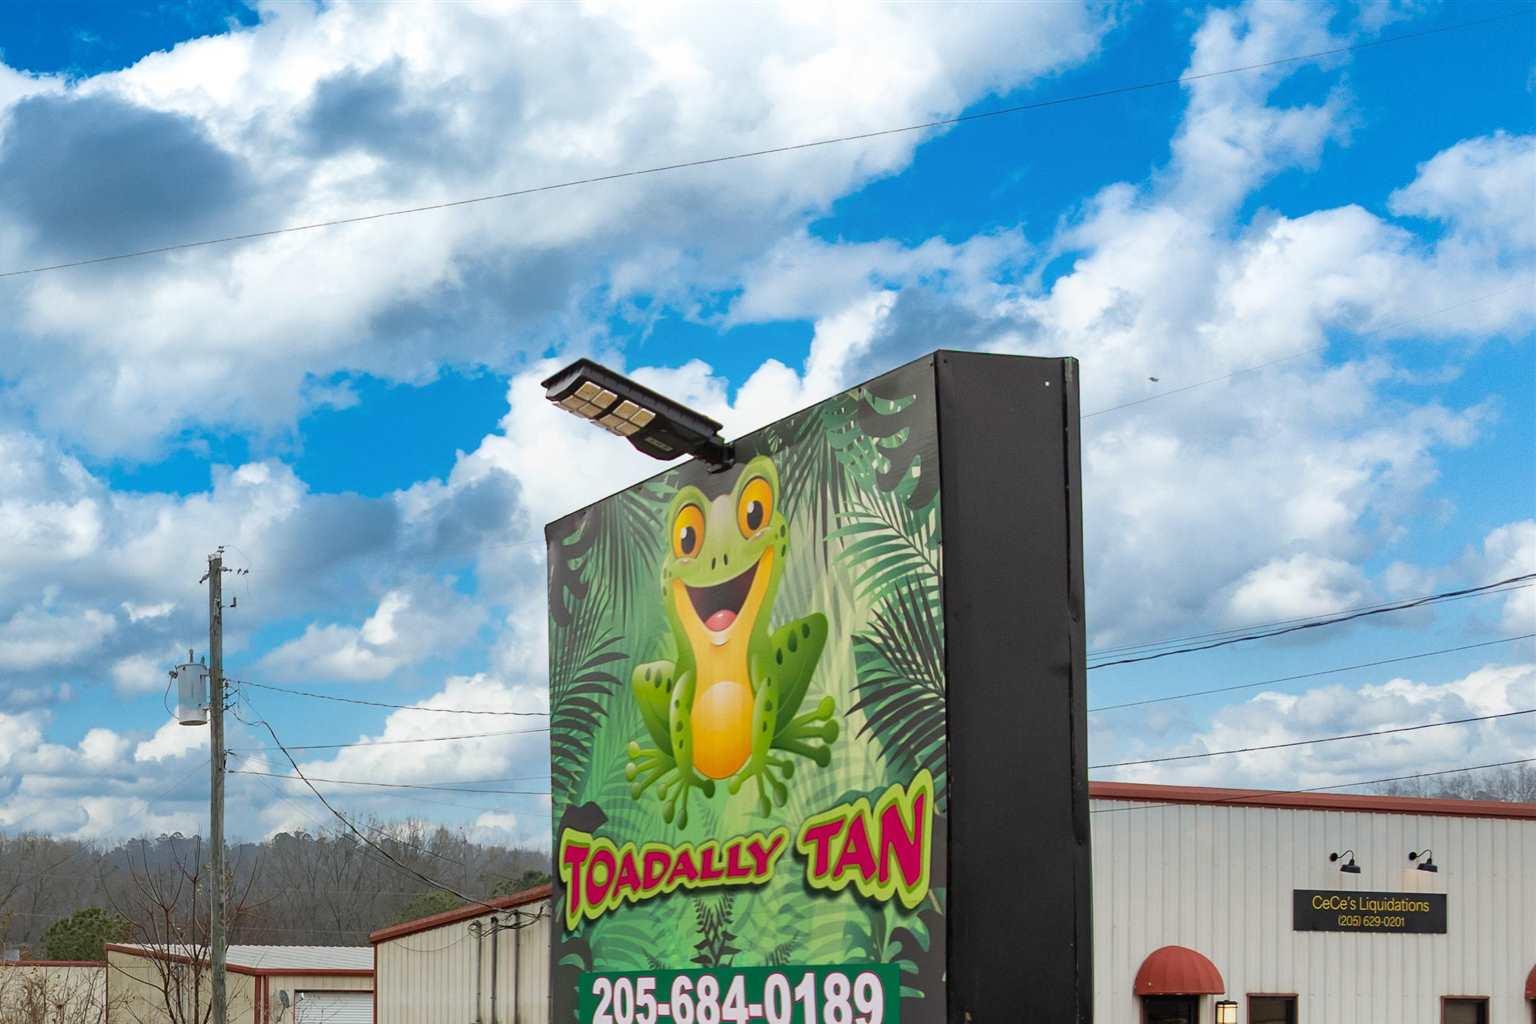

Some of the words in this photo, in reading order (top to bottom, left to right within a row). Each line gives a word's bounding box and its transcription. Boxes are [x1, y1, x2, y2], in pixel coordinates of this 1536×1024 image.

[562, 829, 787, 920] TOADALLY
[800, 776, 930, 898] TAN
[1312, 895, 1357, 911] CeCe's
[1359, 896, 1430, 914] Liquidations
[1337, 915, 1362, 928] (205)
[1363, 915, 1406, 928] 629-0201
